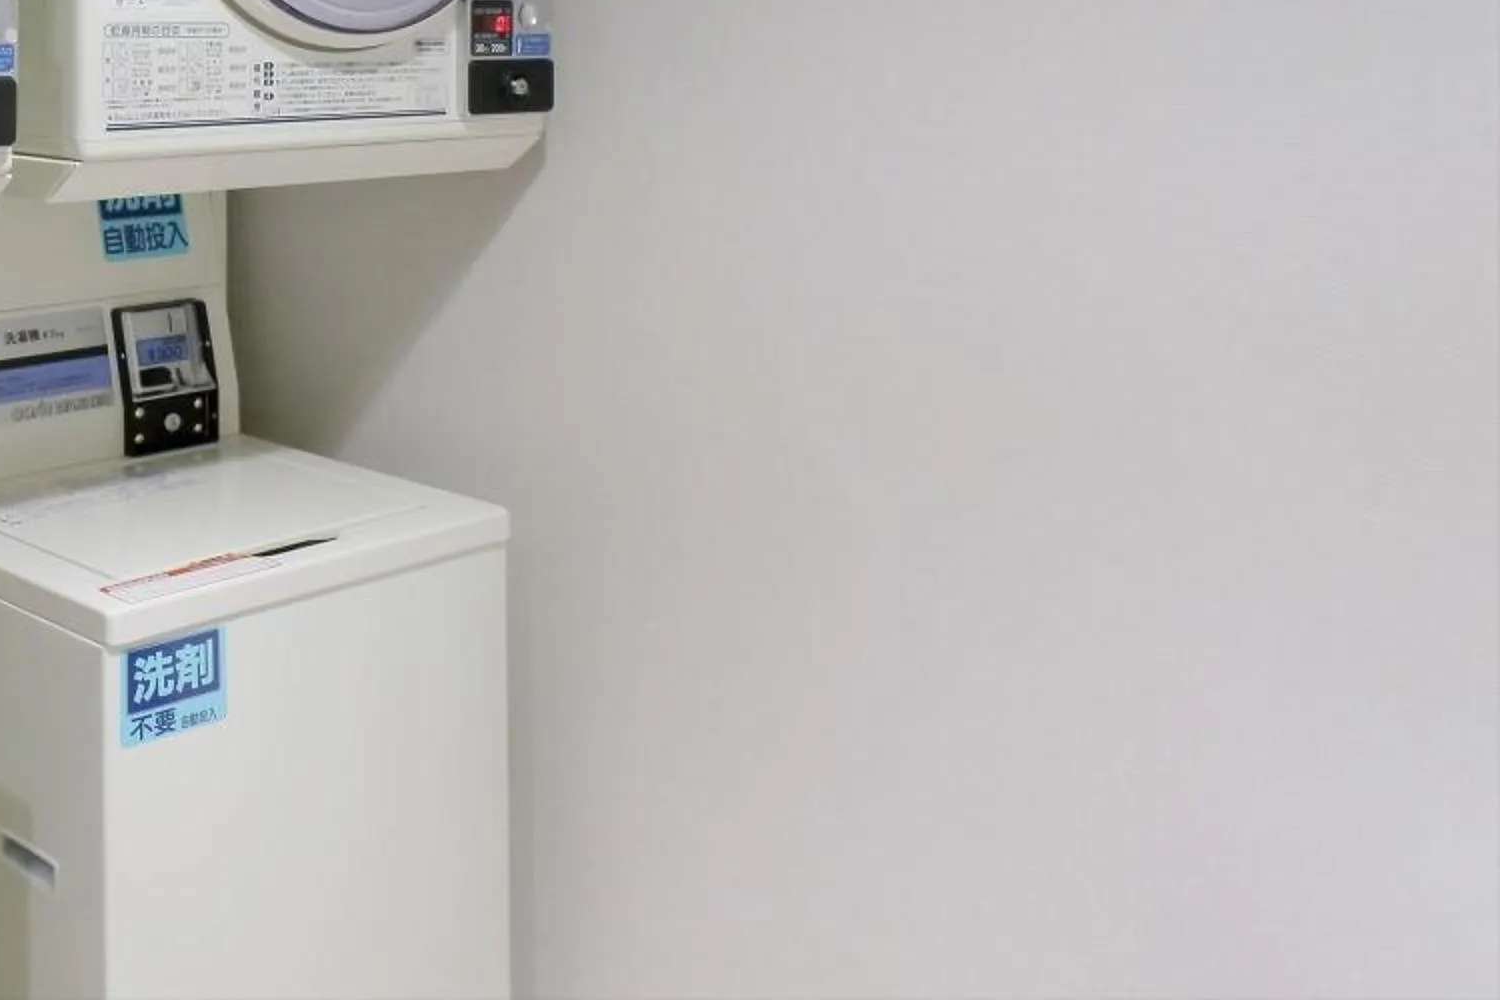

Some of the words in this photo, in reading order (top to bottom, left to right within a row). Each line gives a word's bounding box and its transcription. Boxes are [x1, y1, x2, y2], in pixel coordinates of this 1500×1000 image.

[103, 221, 189, 255] 自動投入
[132, 638, 214, 705] 洗剤
[129, 707, 177, 742] 不要
